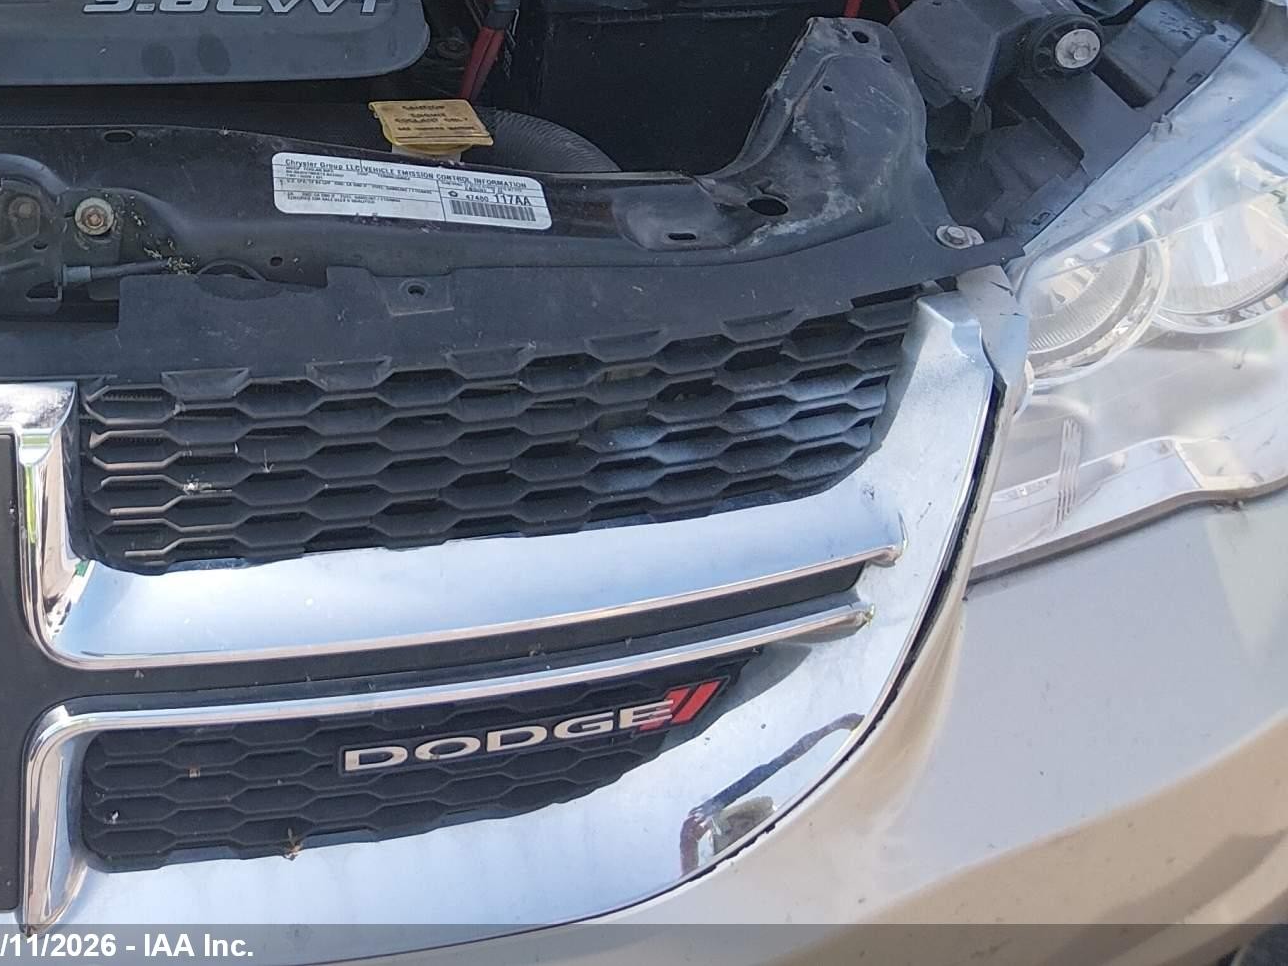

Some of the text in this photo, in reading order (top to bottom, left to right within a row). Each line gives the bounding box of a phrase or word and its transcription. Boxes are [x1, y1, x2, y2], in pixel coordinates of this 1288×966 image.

[285, 159, 360, 172] Chrysler Group LLC
[363, 165, 394, 175] VEHICLE
[398, 170, 434, 179] EMISSION
[436, 174, 469, 183] CONTROL
[473, 177, 527, 188] INFORMATION
[494, 194, 532, 206] 117AA
[344, 699, 674, 772] DODGE
